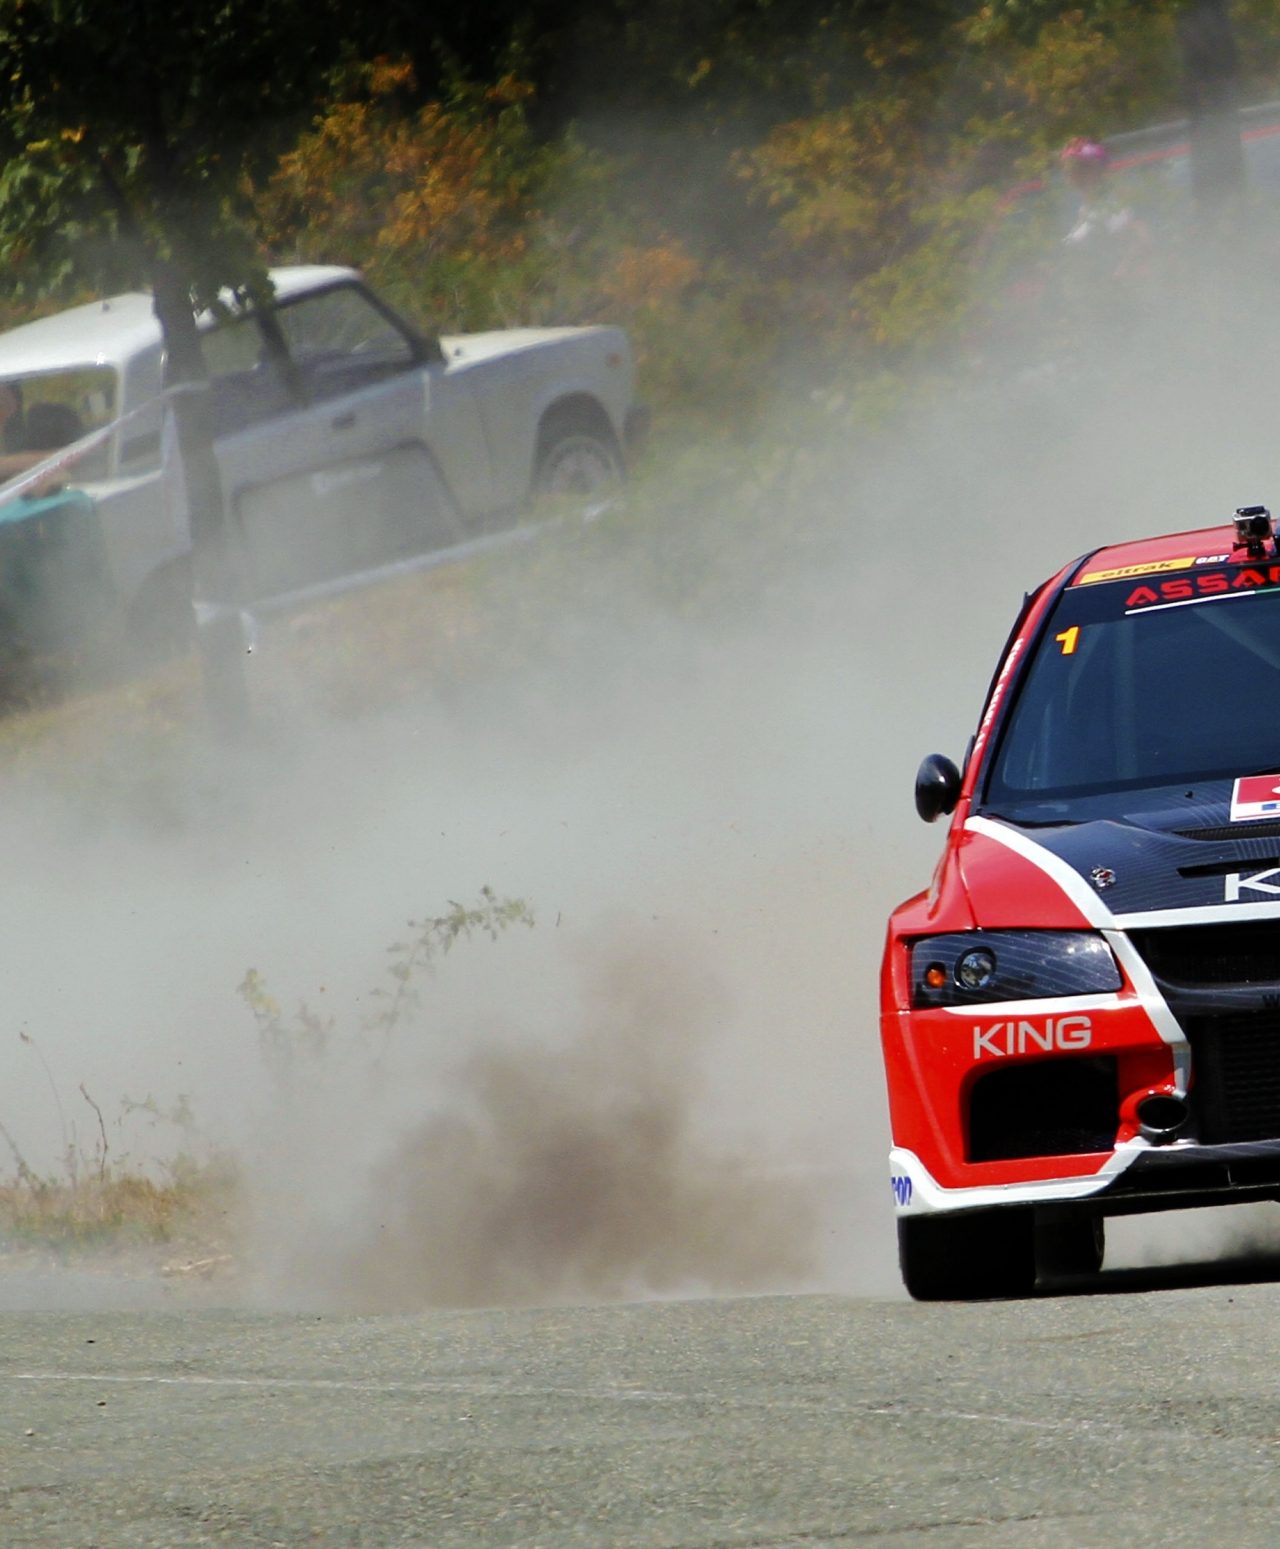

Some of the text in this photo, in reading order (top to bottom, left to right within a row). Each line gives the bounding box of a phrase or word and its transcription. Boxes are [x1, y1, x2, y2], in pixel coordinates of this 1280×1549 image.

[1101, 561, 1174, 579] eltrak
[1055, 626, 1081, 655] 1
[973, 1016, 1092, 1060] KING
